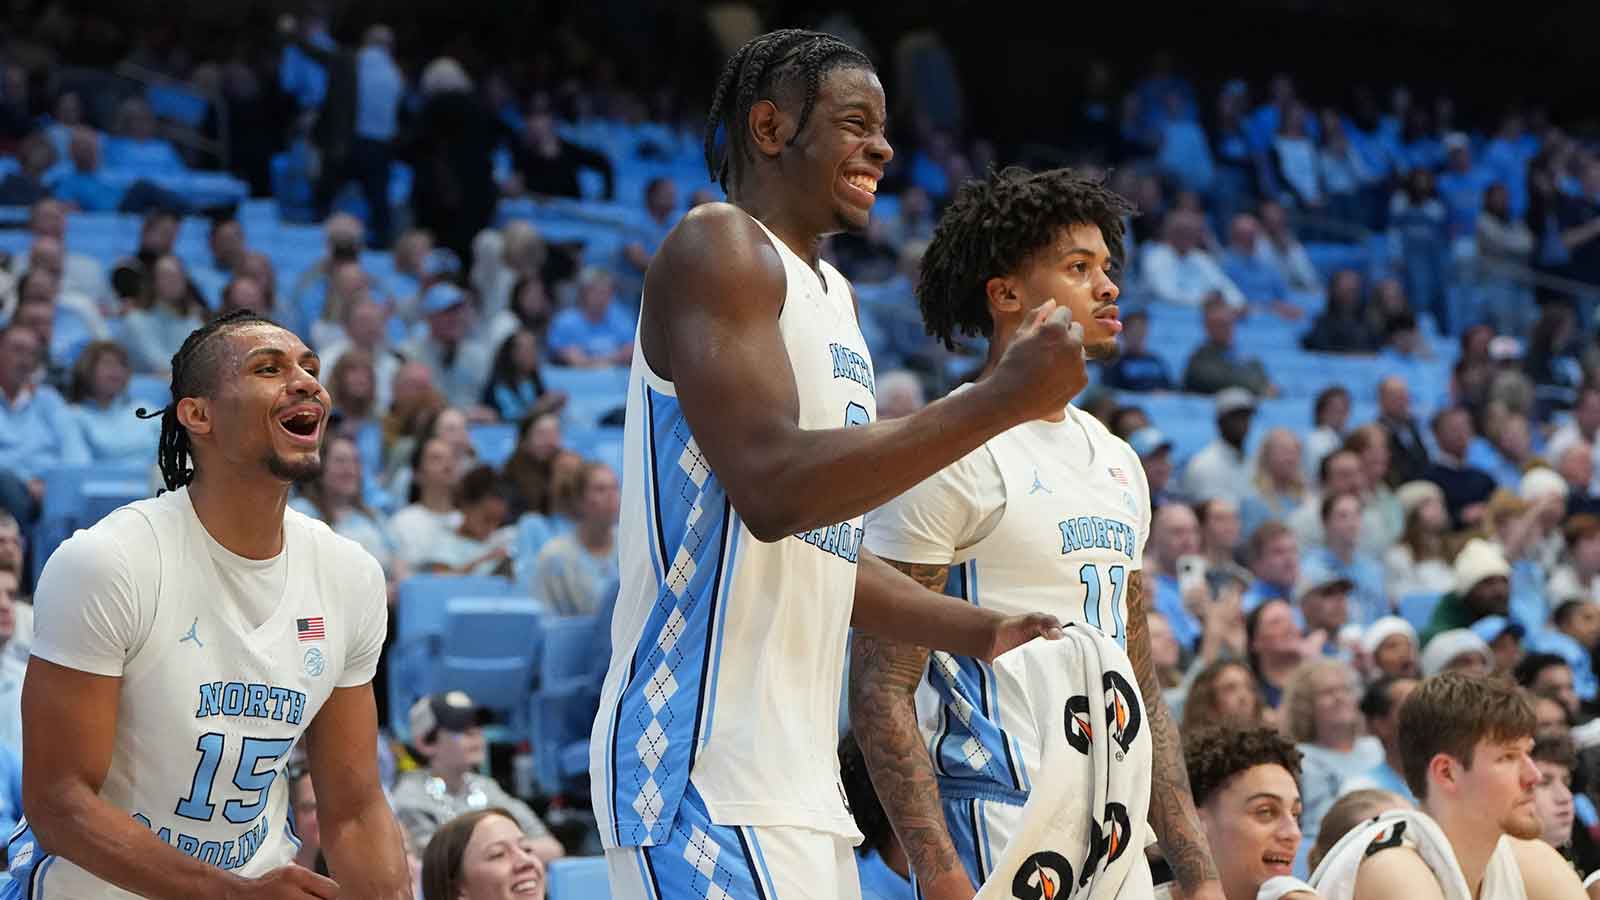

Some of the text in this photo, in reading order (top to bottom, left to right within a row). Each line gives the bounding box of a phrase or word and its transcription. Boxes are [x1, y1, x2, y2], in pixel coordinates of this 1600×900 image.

[1058, 516, 1136, 560] NORTH
[1080, 563, 1126, 650] 11
[196, 681, 307, 725] NORTH
[174, 732, 295, 824] 15
